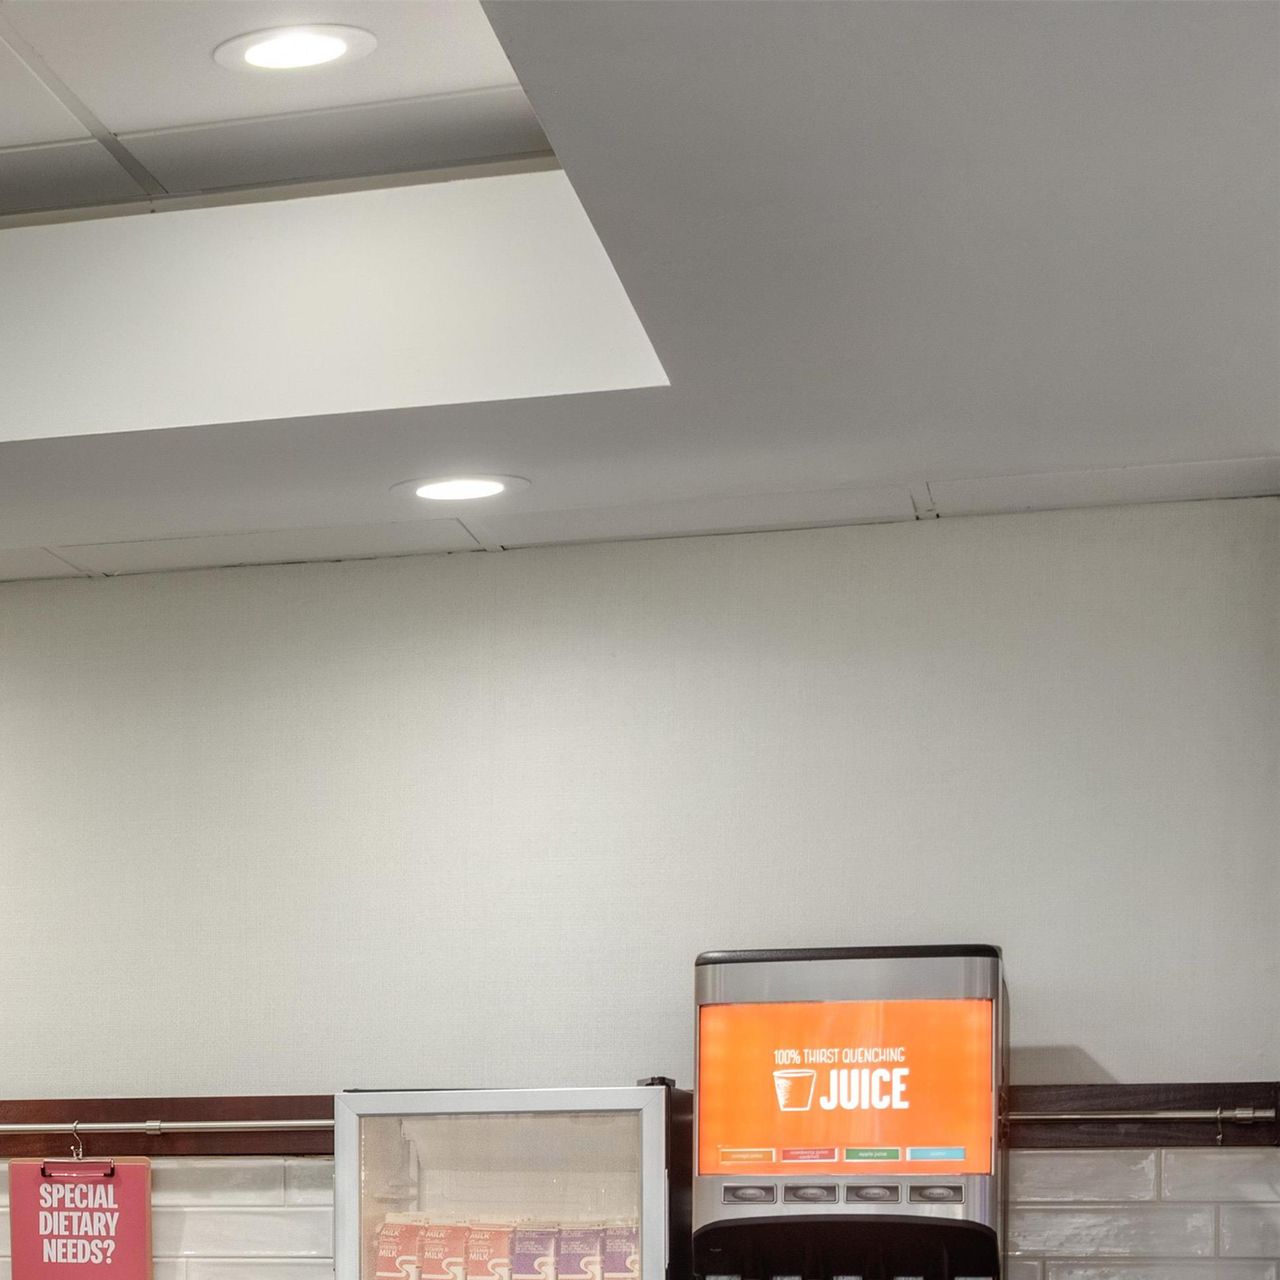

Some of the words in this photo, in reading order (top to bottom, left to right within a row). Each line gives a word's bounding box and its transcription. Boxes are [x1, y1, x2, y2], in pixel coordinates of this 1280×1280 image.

[773, 1049, 801, 1065] 100%
[803, 1048, 840, 1064] THIRST
[842, 1046, 906, 1063] QUENCHING
[819, 1067, 910, 1111] JUICE
[39, 1183, 119, 1209] SPECIAL
[39, 1211, 120, 1236] DIETARY
[43, 1239, 116, 1264] NEEDS?
[378, 1249, 398, 1258] MILK
[424, 1251, 445, 1260] MILK
[469, 1252, 489, 1261] MILK
